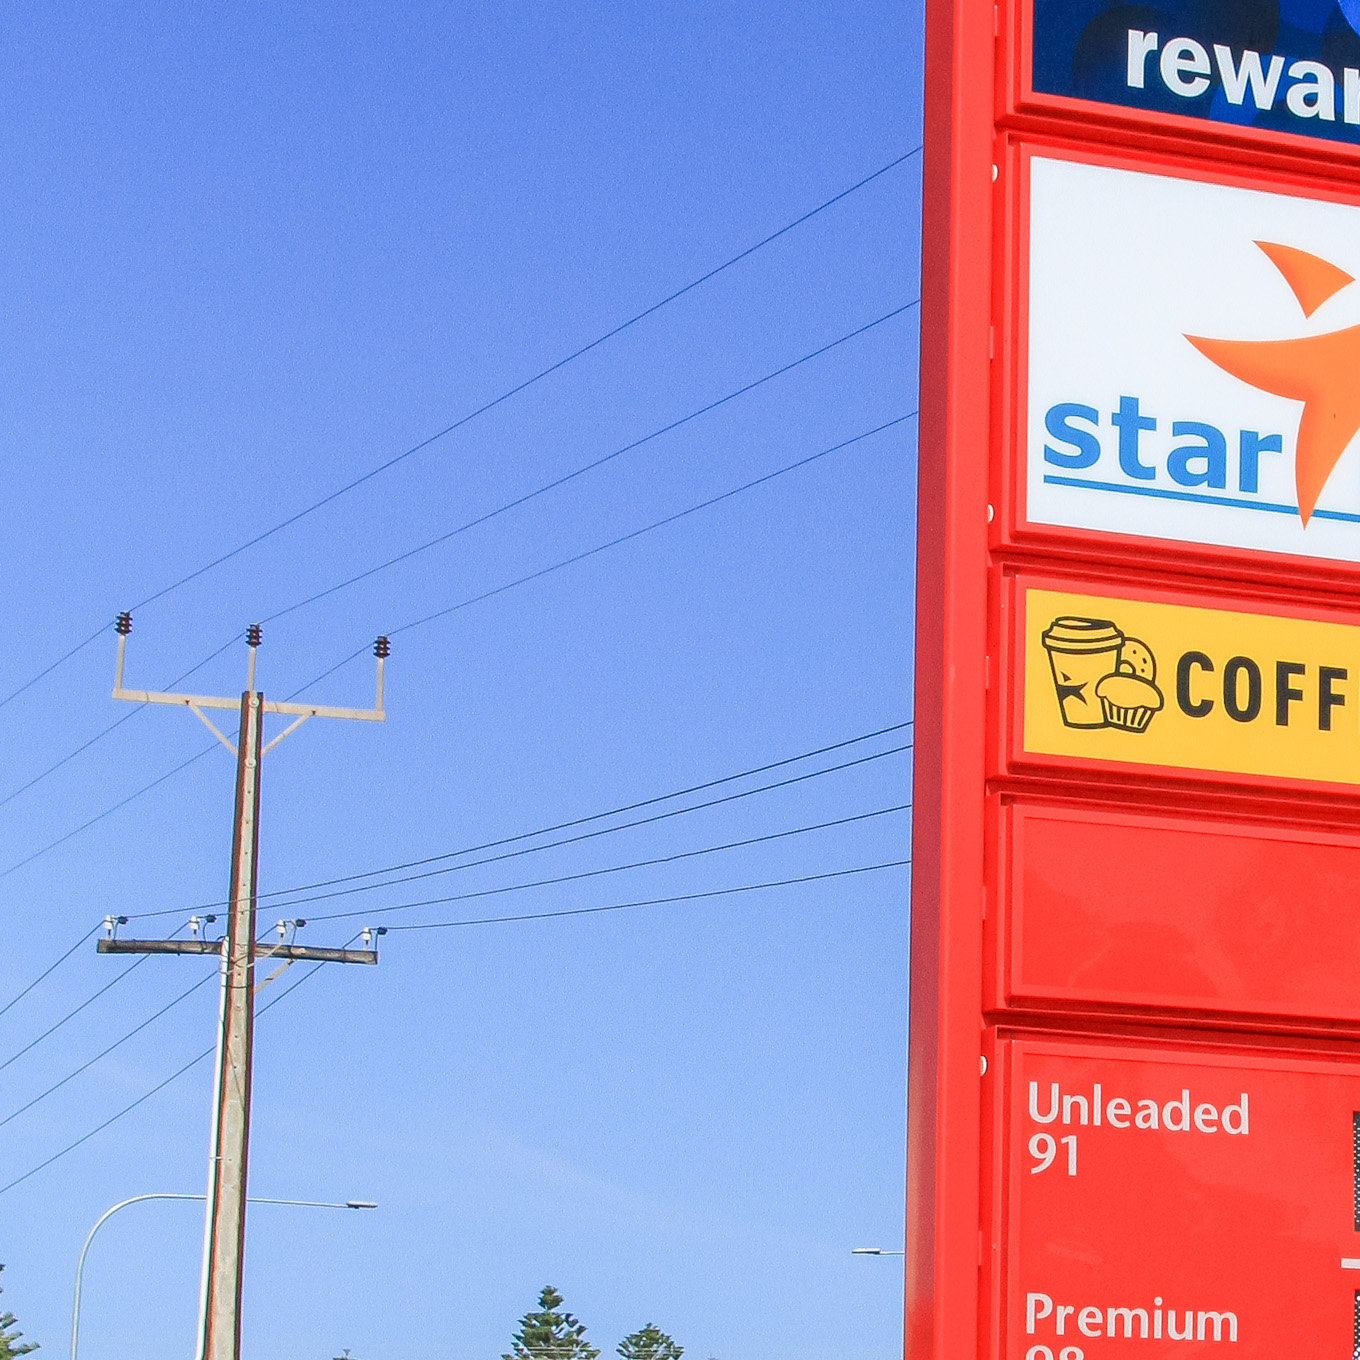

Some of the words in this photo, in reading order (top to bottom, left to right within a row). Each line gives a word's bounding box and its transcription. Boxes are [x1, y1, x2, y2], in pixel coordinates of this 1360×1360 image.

[1043, 395, 1283, 494] star
[1027, 1081, 1250, 1136] Unleaded
[1028, 1133, 1078, 1177] 91
[1026, 1292, 1239, 1343] Premium
